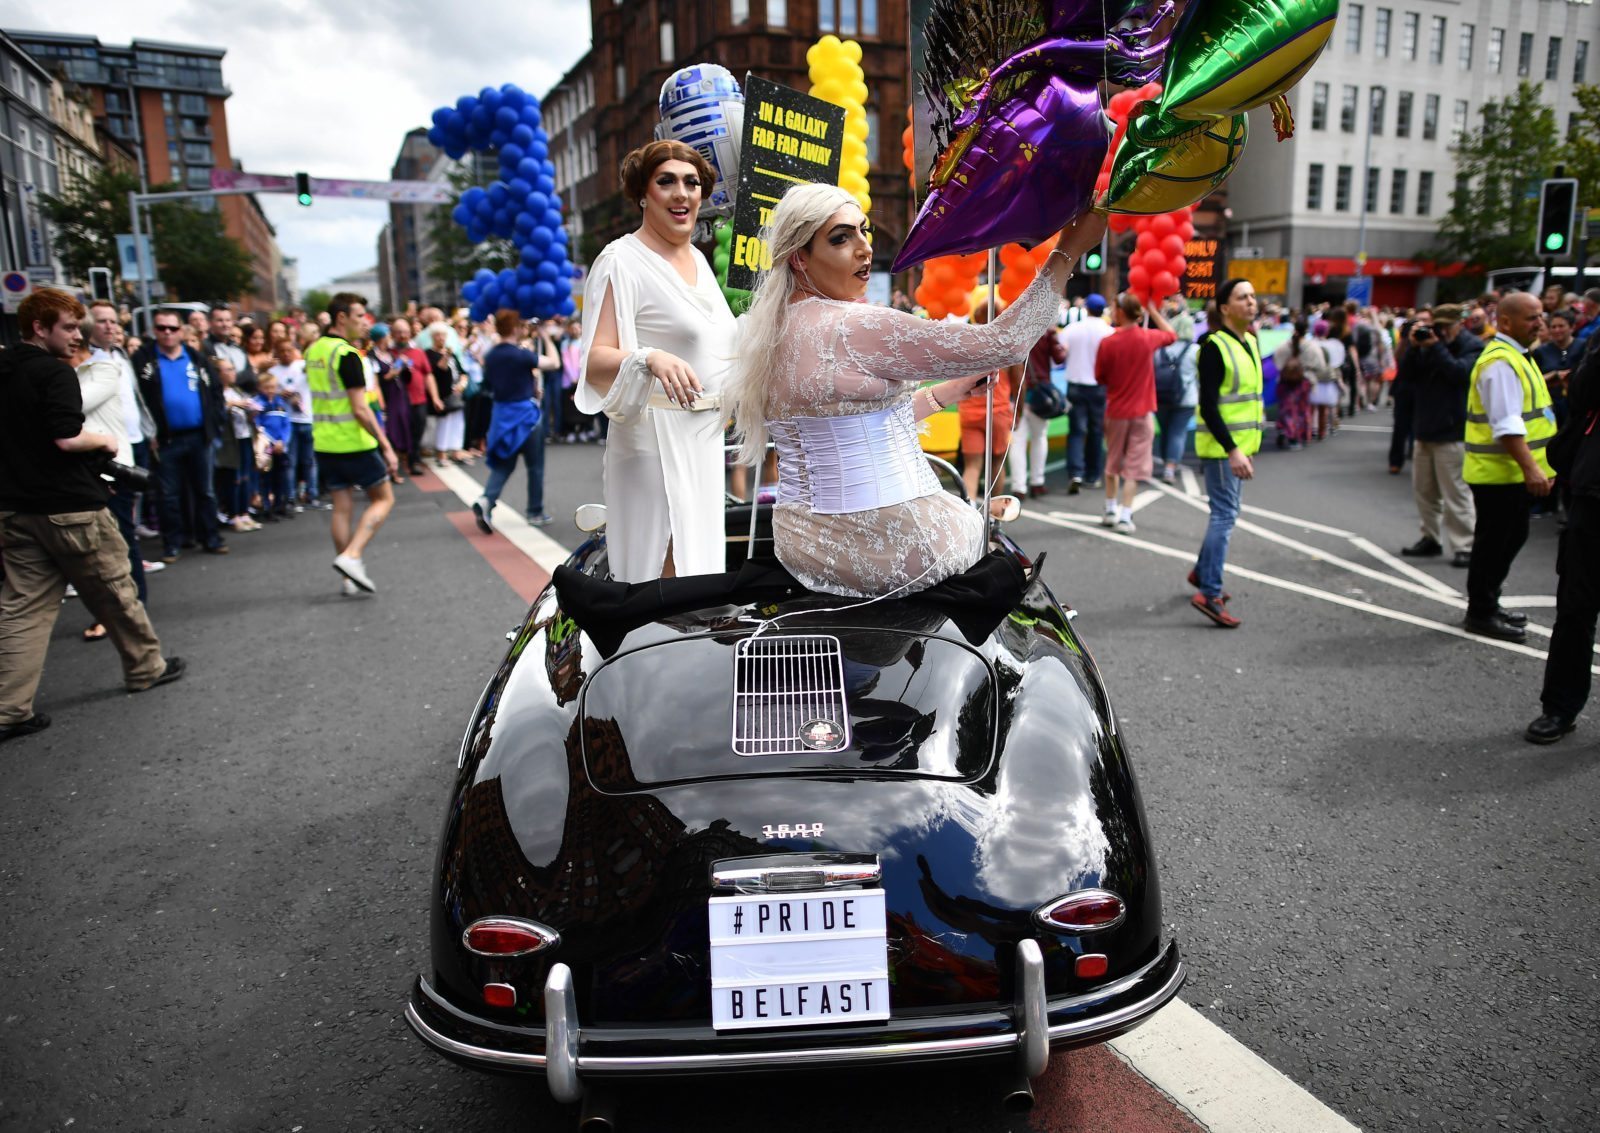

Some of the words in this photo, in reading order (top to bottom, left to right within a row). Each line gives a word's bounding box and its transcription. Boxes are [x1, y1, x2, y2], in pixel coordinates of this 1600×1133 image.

[759, 101, 773, 123] IN
[774, 106, 784, 126] A
[785, 109, 828, 139] GALAXY
[752, 126, 775, 150] FAR
[776, 133, 799, 157] FAR
[799, 140, 832, 166] AWAY
[734, 234, 774, 272] EQU
[1186, 261, 1214, 277] SAT
[762, 823, 824, 832] 1600
[733, 900, 856, 935] #PRIDE
[731, 982, 873, 1019] BELFAST
